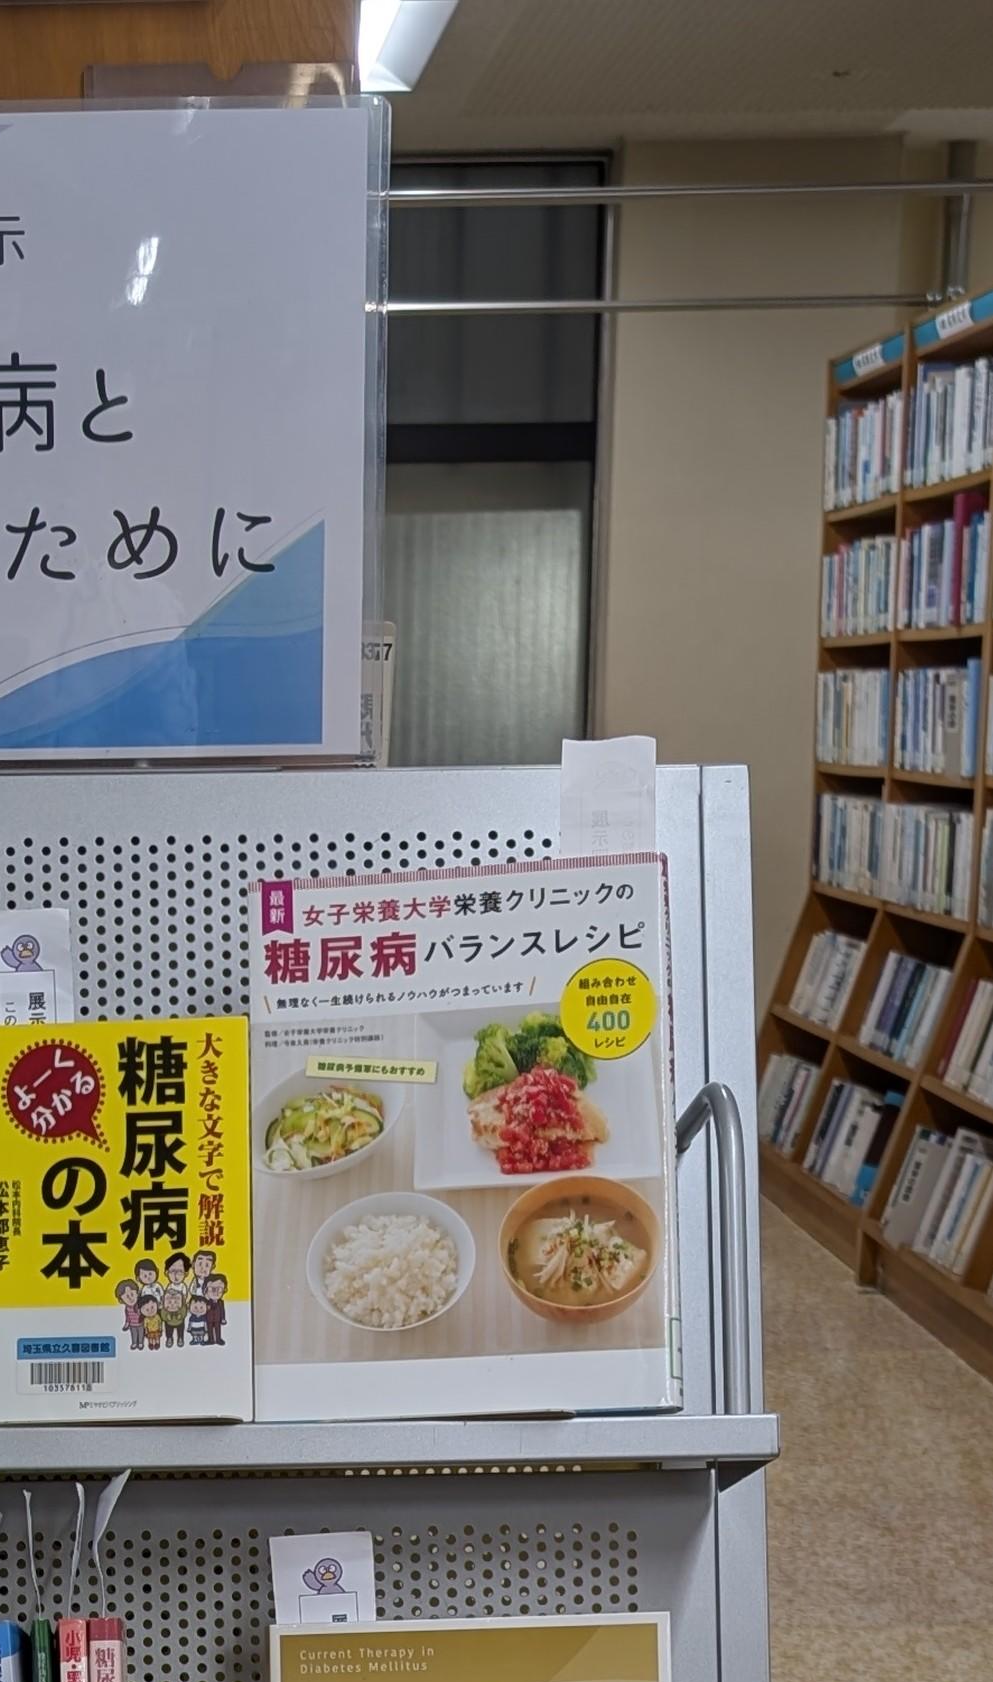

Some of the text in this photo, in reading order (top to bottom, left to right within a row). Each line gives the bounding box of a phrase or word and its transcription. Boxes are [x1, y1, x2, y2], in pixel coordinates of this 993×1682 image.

[269, 888, 285, 925] 最新
[303, 881, 634, 927] 女子栄養大学栄養クリニックの
[264, 921, 645, 985] 糖尿病バランスレシピ
[276, 981, 524, 1010] 無理なく一生続けられるノウハウがつまっています
[579, 975, 637, 990] 組み合わせ
[585, 993, 632, 1006] 自由自在
[586, 1010, 631, 1031] 400
[594, 1036, 626, 1048] レシピ
[14, 1049, 74, 1109] よーく
[31, 1071, 95, 1134] 分かる
[118, 1035, 189, 1251] 糖尿病
[196, 1032, 225, 1247] 大きな文字で解説
[41, 1157, 110, 1289] の本
[299, 1646, 434, 1661] Current Therapy in
[300, 1660, 428, 1675] Diabetes Mellitus
